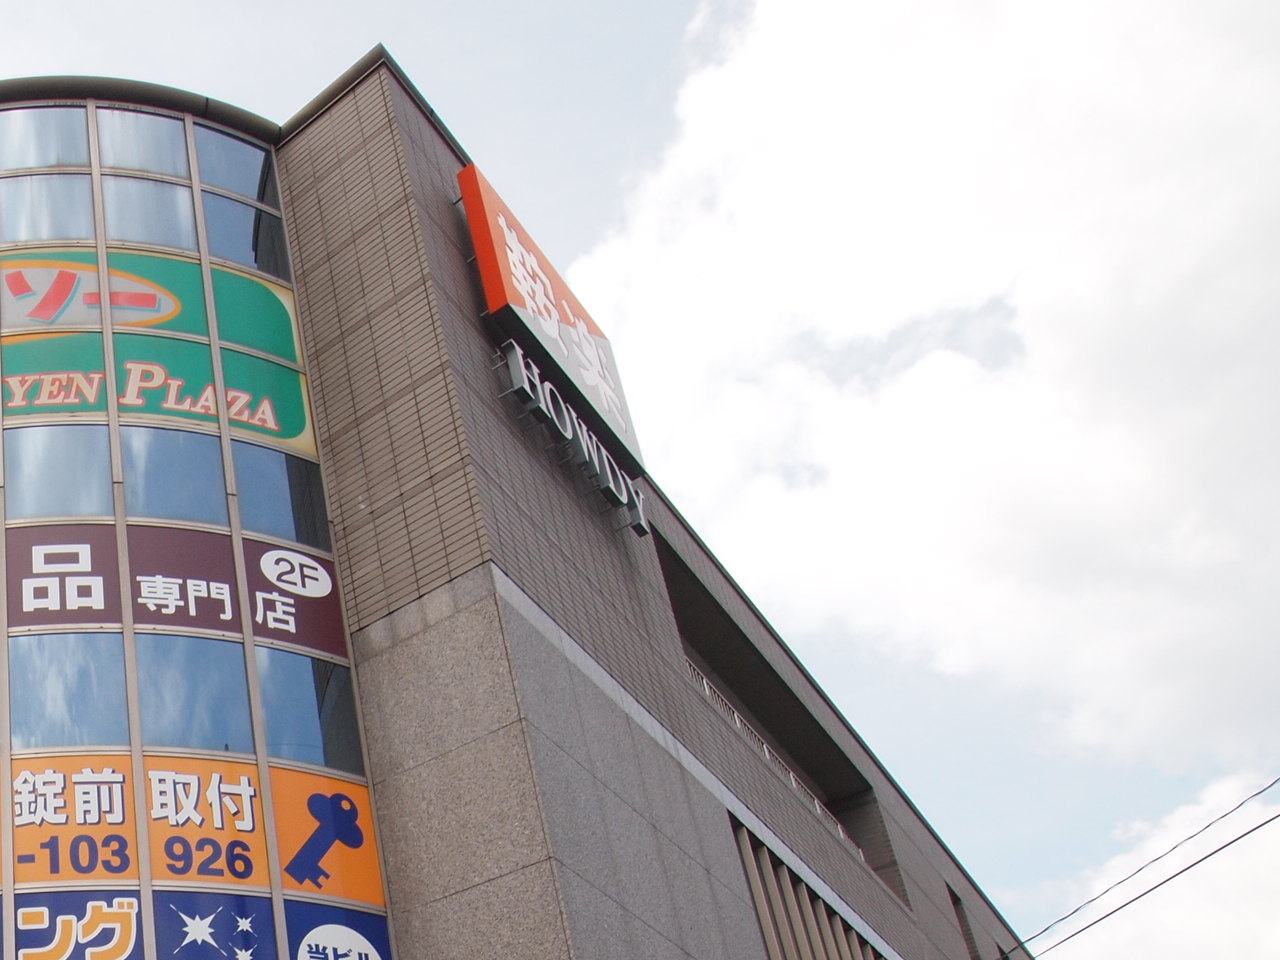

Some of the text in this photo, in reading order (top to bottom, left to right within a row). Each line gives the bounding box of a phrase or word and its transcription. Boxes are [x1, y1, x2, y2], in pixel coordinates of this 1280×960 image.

[4, 372, 106, 409] YEN
[119, 361, 280, 433] PLAZA
[504, 339, 650, 537] HOWDY
[274, 557, 320, 589] 2F
